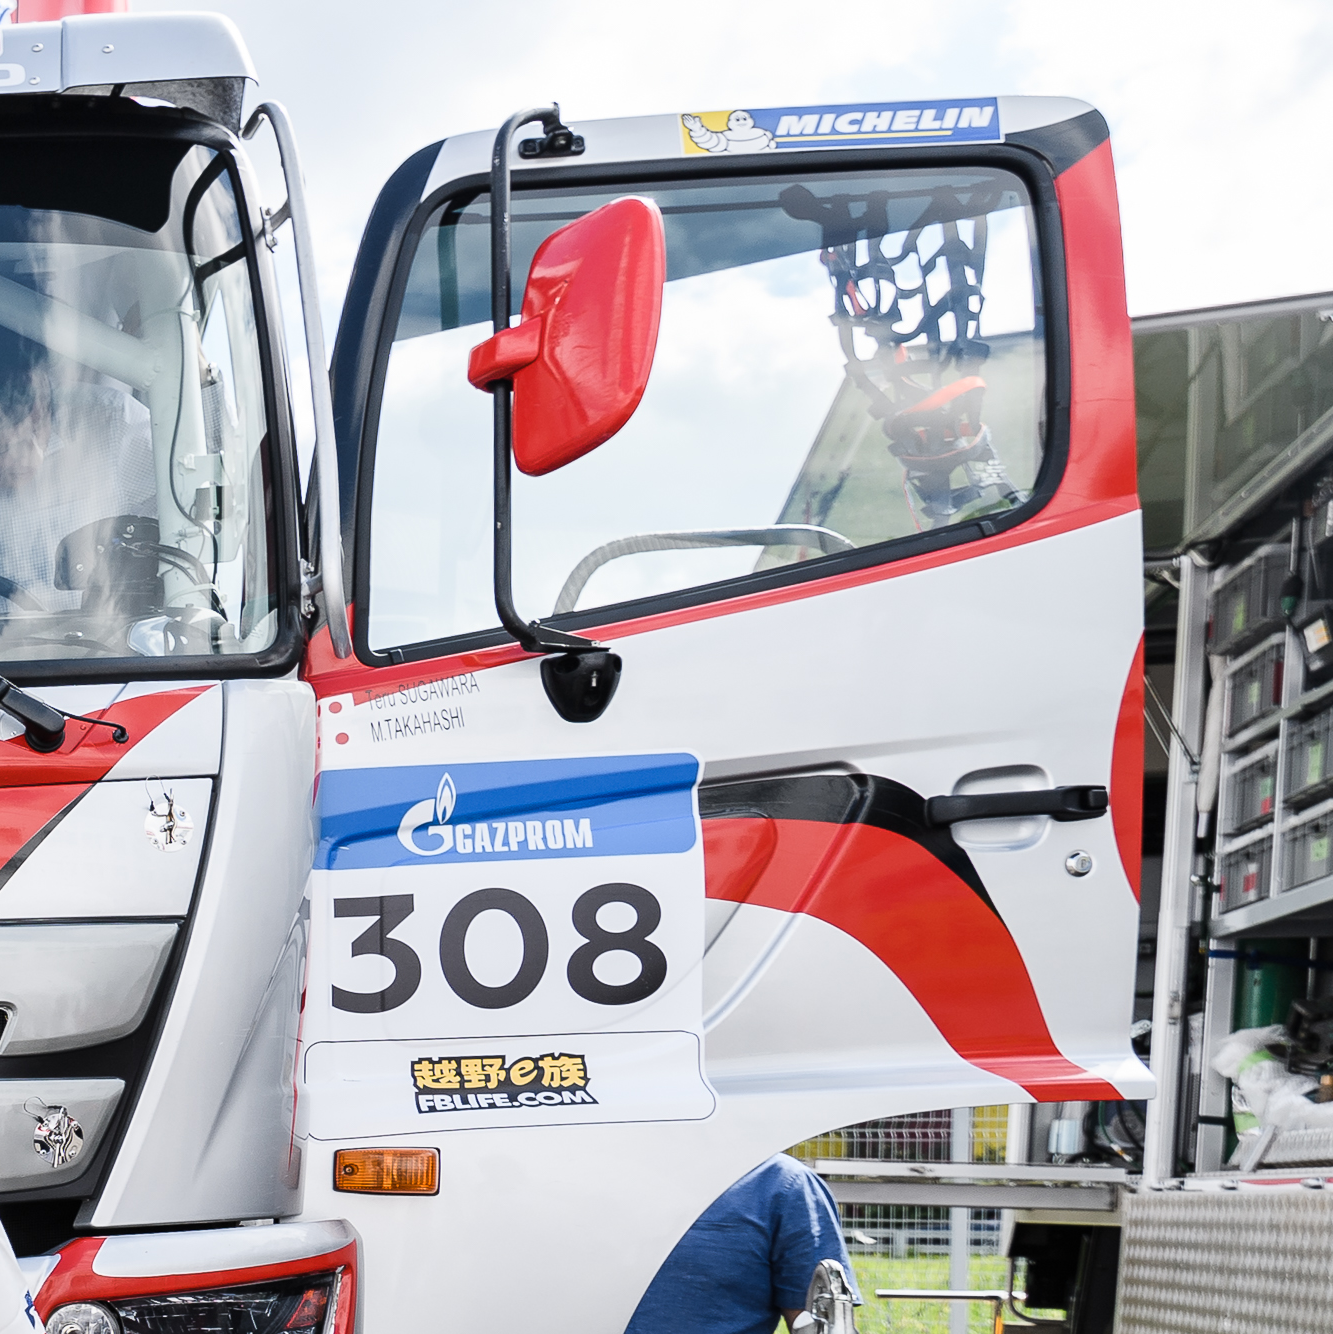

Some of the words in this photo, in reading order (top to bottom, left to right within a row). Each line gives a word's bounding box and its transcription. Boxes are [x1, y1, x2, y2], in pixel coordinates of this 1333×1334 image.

[775, 106, 995, 136] MICHELIN
[364, 689, 396, 711] Teru
[398, 672, 480, 706] SUGAWARA
[370, 706, 465, 743] M.TAKAHASHI
[455, 817, 594, 855] GAZPROM
[331, 882, 668, 1014] 308
[414, 1055, 586, 1089] 越野e族
[418, 1090, 595, 1112] FBLIFE.COM
